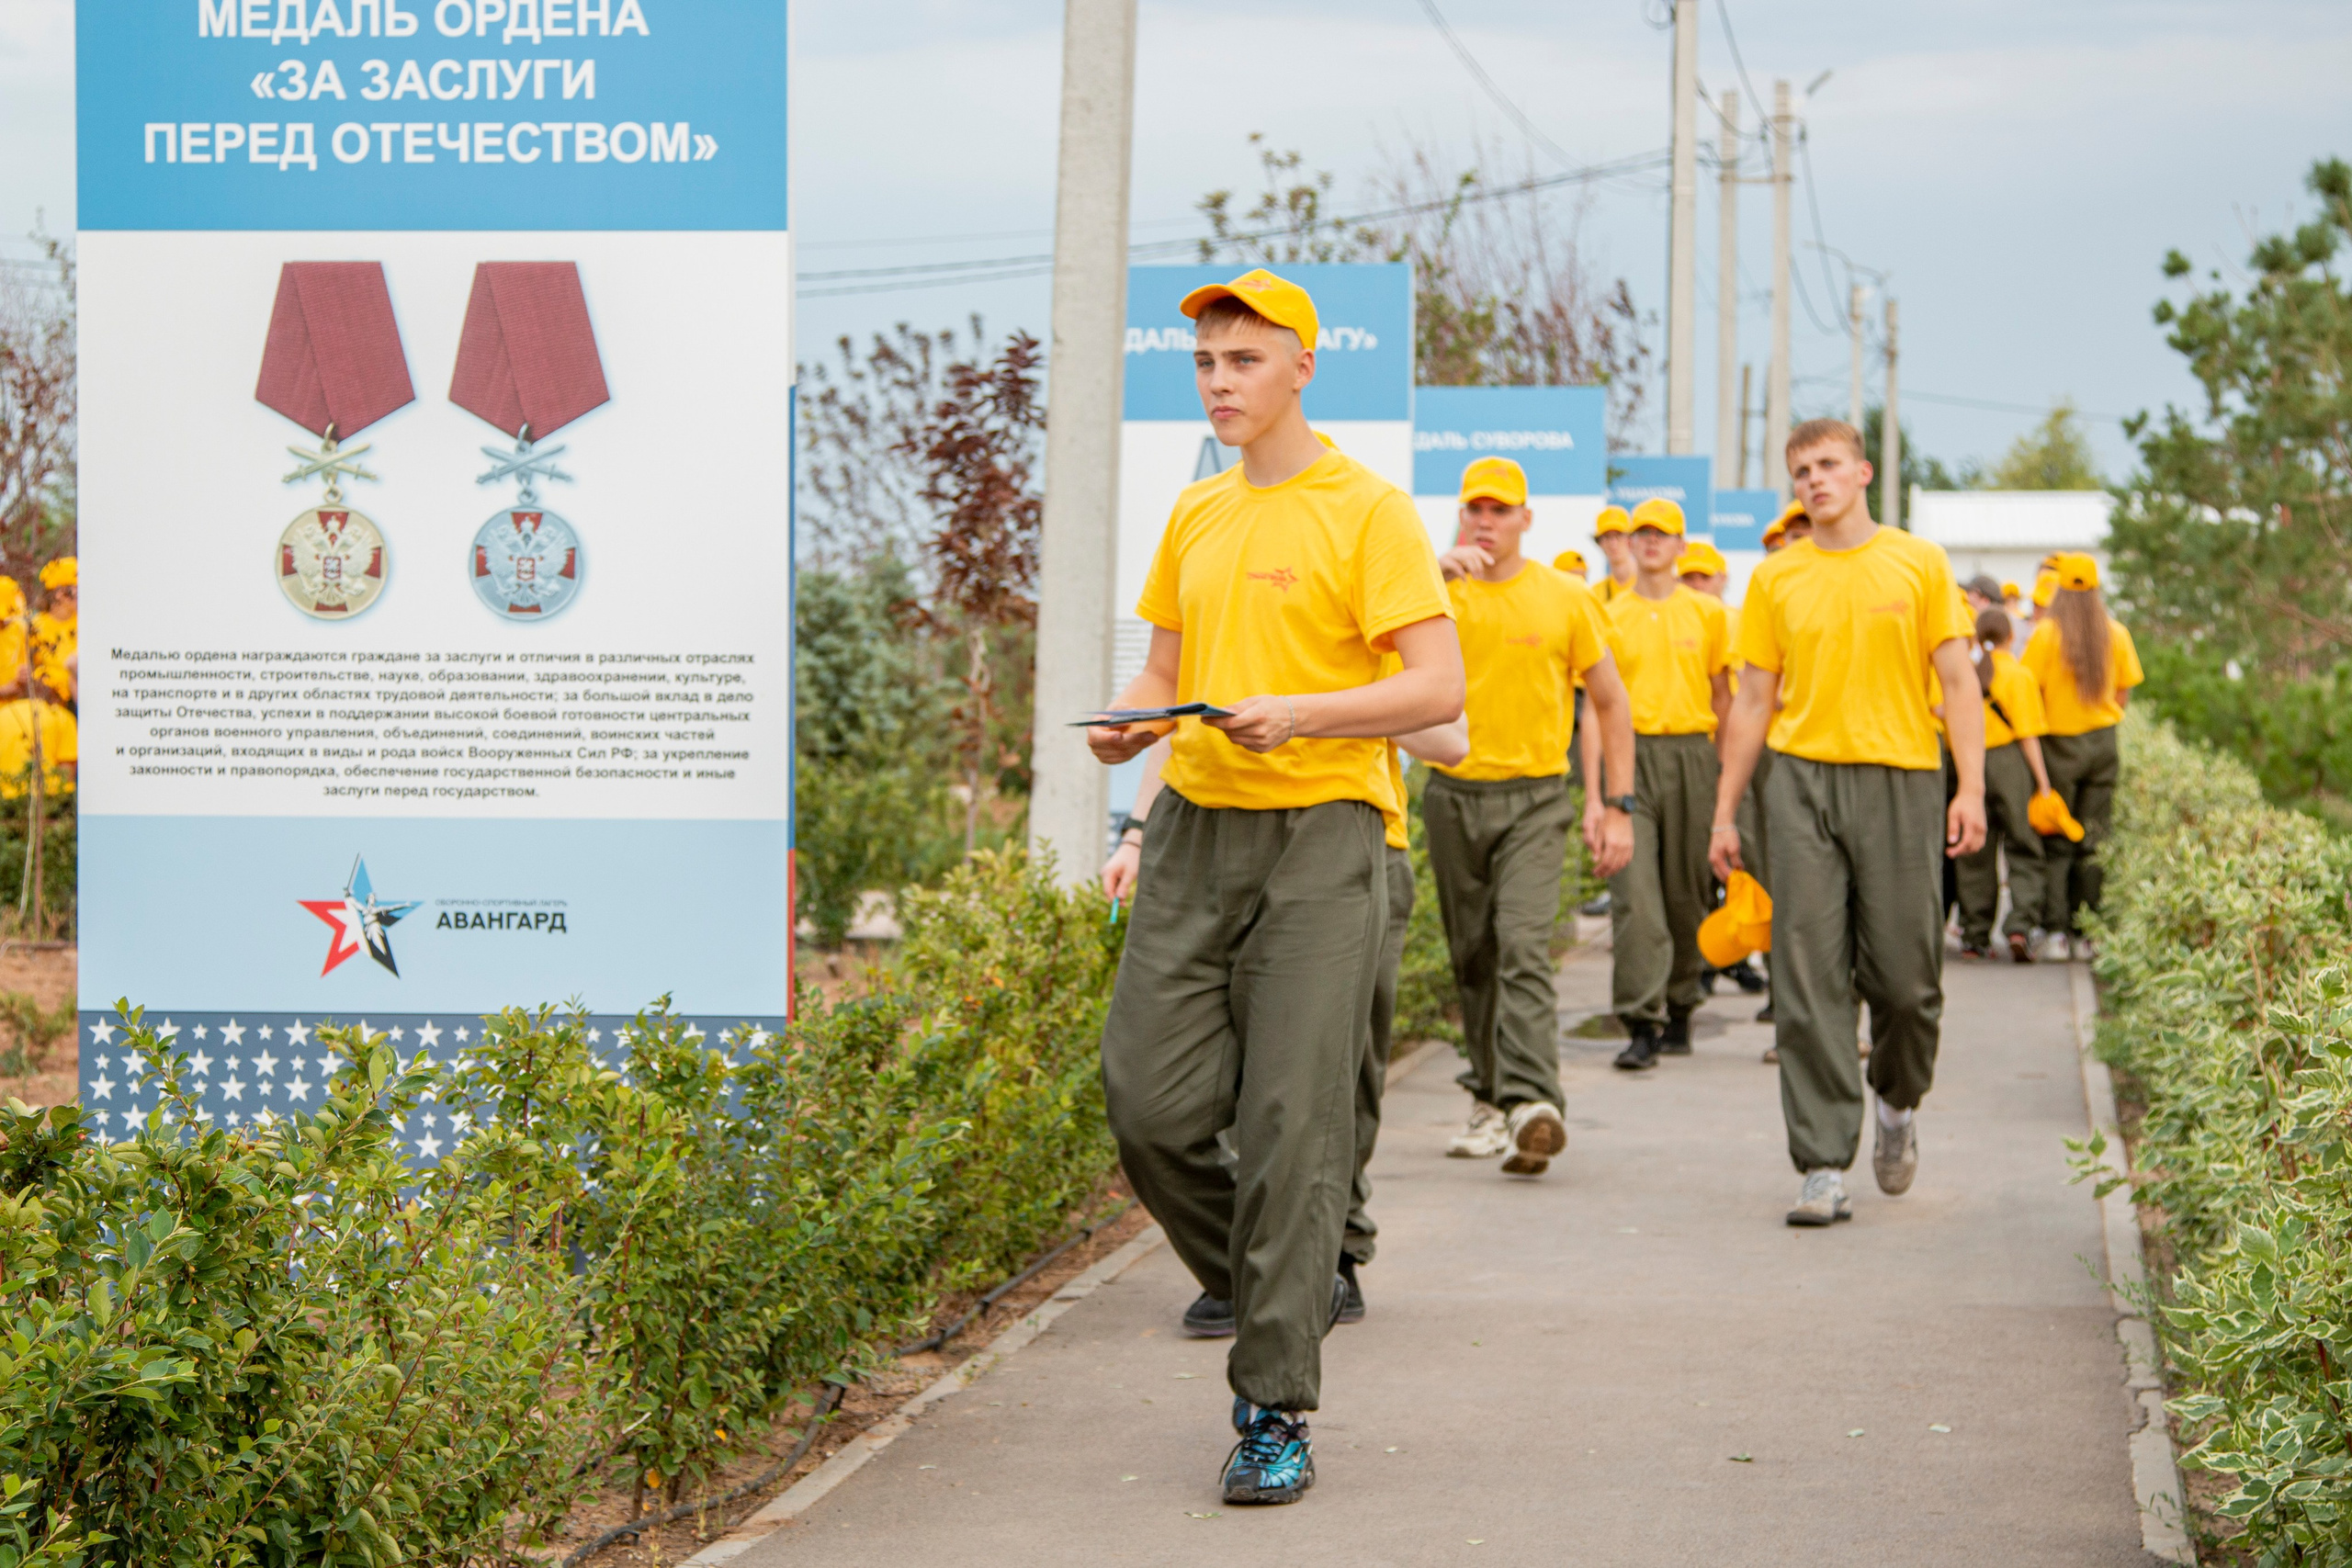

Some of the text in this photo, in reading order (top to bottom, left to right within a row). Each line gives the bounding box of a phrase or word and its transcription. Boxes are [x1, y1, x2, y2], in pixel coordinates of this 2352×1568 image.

[198, 0, 650, 45] МЕДАЛЬ ОРДЕНА
[250, 59, 596, 101] «ЗА ЗАСЛУГИ
[143, 121, 718, 172] ПЕРЕД ОТЕЧЕСТВОМ»
[1469, 430, 1574, 451] СУВОРОВА
[109, 648, 755, 666] Медалью ордена награждаются граждане за заслуги и отличия в различных отраслях
[119, 669, 746, 686] промышленности, строительстве, науке, образовании, здравоохранении, культуре,
[110, 687, 755, 704] на транспорте и в других областях трудовой деятельности; за большой вклад в дело
[114, 705, 751, 723] защиты Отечества, успехи в поддержании высокой боевой готовности центральных
[148, 727, 717, 741] органов военного управления, объединений, соединений, воинских частей
[115, 746, 751, 762] и организаций, входящих в виды и рода войск Вооруженных Сил РФ; за укрепление
[129, 764, 737, 780] законности и правопорядка, обеспечение государственной безопасности и иные
[322, 785, 540, 799] заслуги перед государством.
[435, 911, 567, 933] АВАНГАРД
